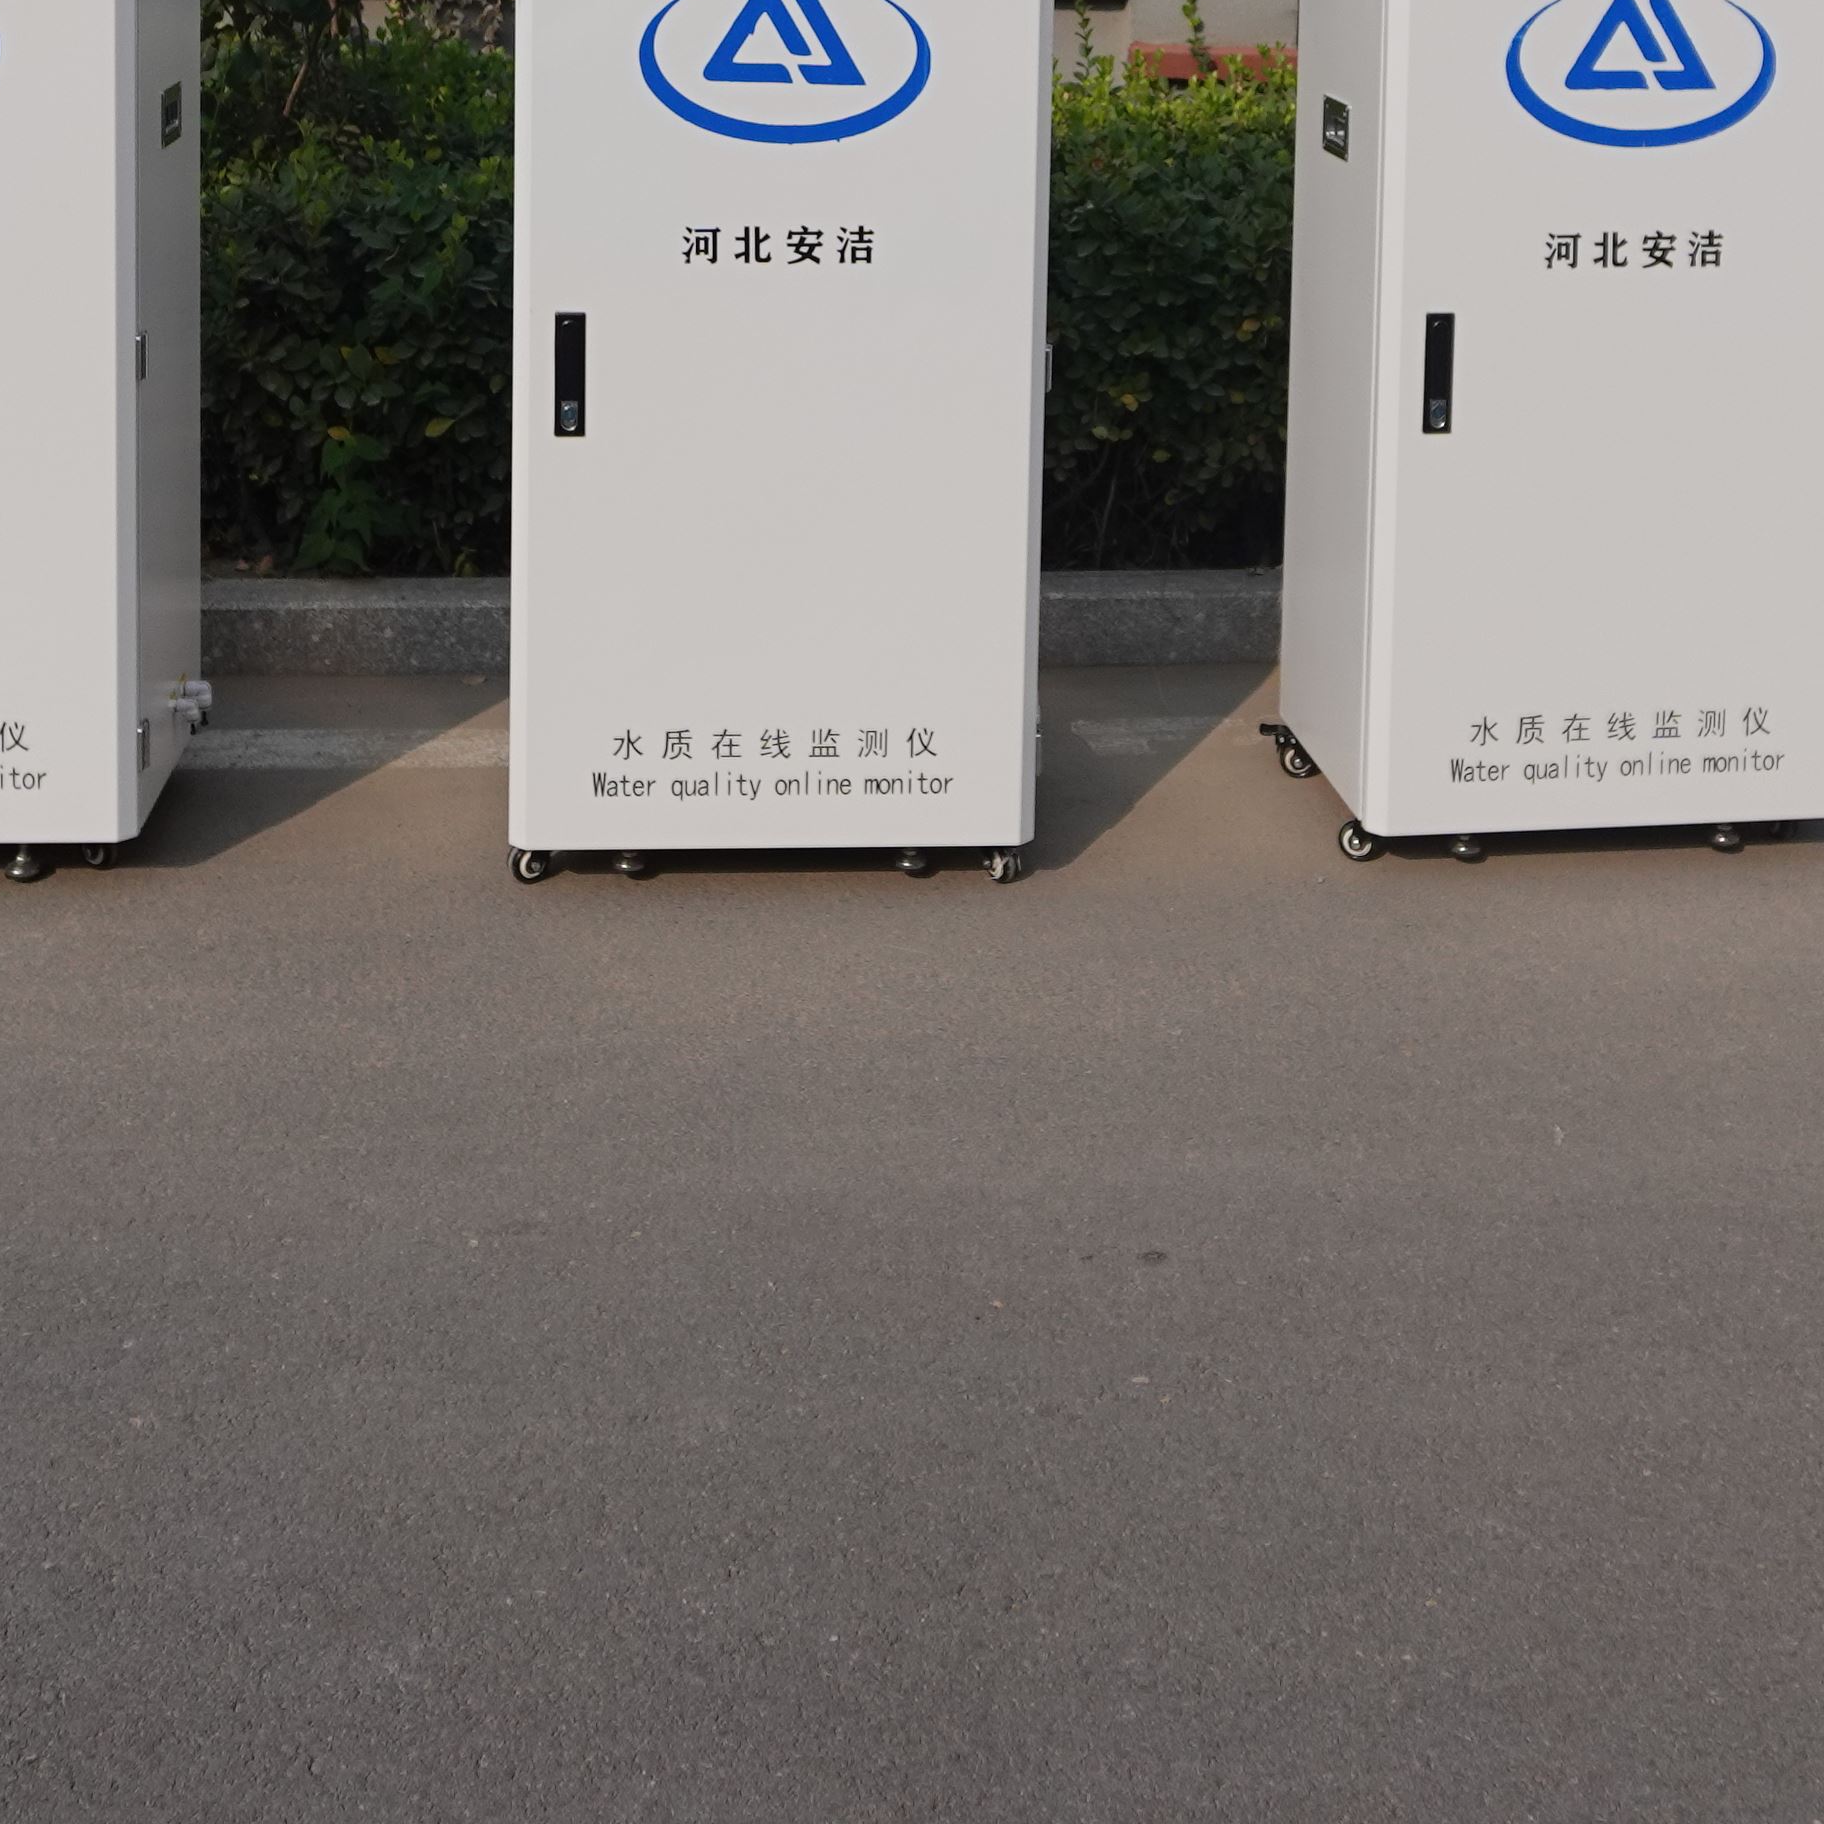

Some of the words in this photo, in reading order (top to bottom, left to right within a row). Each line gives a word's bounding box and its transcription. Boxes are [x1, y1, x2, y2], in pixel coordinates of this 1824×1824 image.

[681, 224, 875, 266] 河北安洁
[1543, 229, 1724, 270] 河北安洁
[612, 727, 938, 761] 水质在线监测仪
[1469, 706, 1772, 752] 水质在线监测仪
[591, 771, 657, 798] Water
[670, 770, 763, 802] quality
[774, 770, 852, 797] online
[863, 769, 955, 796] monitor
[1450, 757, 1511, 785] Water
[1523, 753, 1609, 785] quality
[1619, 750, 1692, 778] online
[1702, 747, 1785, 774] monitor
